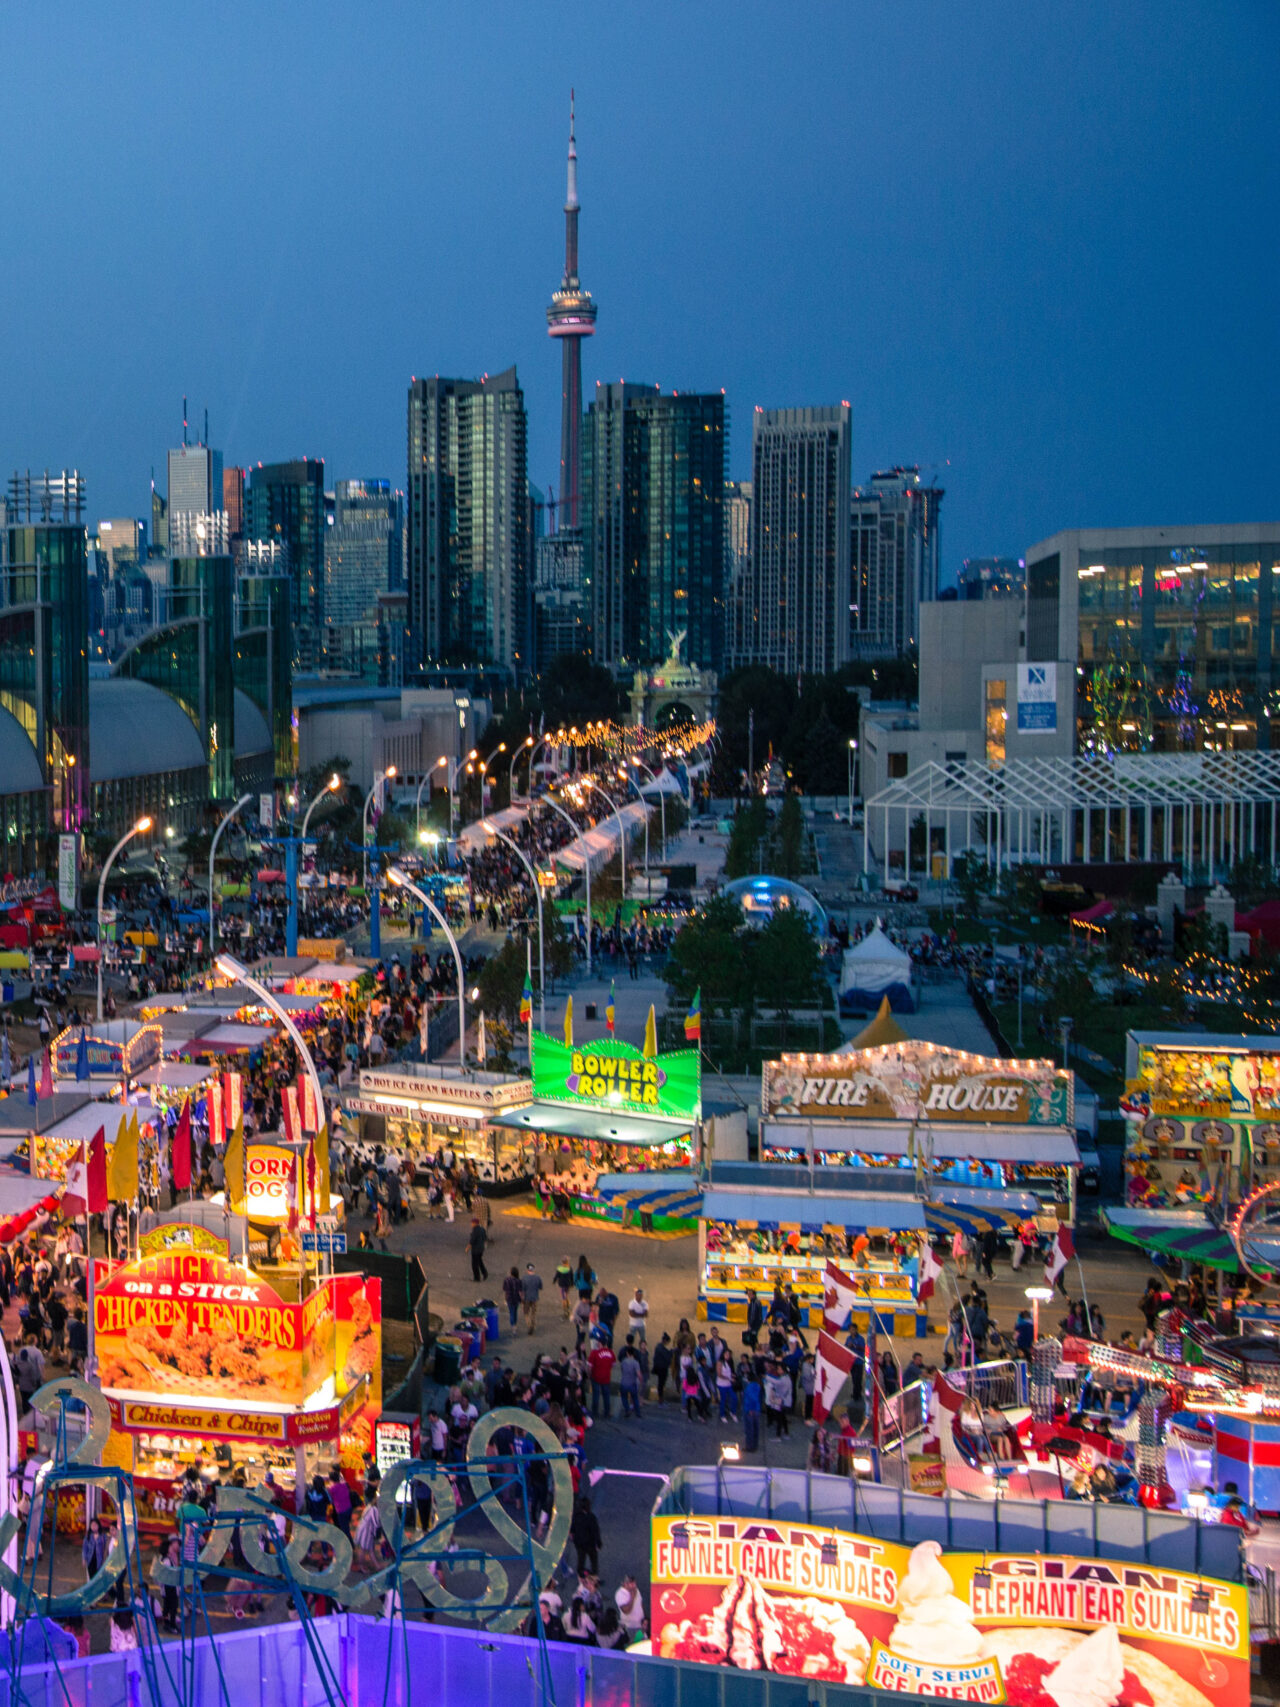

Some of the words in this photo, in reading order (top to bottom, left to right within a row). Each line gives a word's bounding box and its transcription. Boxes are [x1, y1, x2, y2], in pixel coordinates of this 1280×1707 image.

[572, 1053, 658, 1083] BOWLER
[373, 1077, 390, 1087] HOT
[393, 1080, 406, 1089] ICE
[408, 1082, 438, 1093] CREAM
[441, 1087, 481, 1099] WAFFLES
[577, 1075, 659, 1105] ROLLER
[802, 1078, 870, 1107] FIRE
[925, 1084, 1023, 1112] HOUSE
[349, 1100, 365, 1110] ICE
[369, 1104, 403, 1115] CREAM
[419, 1110, 469, 1127] WAFFLES
[249, 1158, 291, 1176] ORN
[249, 1181, 290, 1198] OG
[139, 1255, 248, 1283] CHICKEN
[124, 1281, 153, 1294] on
[158, 1285, 173, 1296] a
[178, 1282, 260, 1302] STICK
[94, 1294, 188, 1334] CHICKEN
[193, 1302, 296, 1350] TENDERS
[127, 1405, 203, 1427] Chicken
[207, 1416, 222, 1429] &
[227, 1413, 280, 1435] Chips
[669, 1520, 884, 1560] GIANT
[658, 1542, 734, 1576] FUNNEL
[741, 1543, 793, 1584] CAKE
[800, 1552, 898, 1606] SUNDAES
[989, 1559, 1230, 1602] GIANT
[972, 1581, 1077, 1620] ELEPHANT
[1085, 1585, 1125, 1624] EAR
[1133, 1590, 1239, 1648] SUNDAES
[878, 1651, 924, 1678] SOFT
[874, 1664, 909, 1692] ICE
[917, 1680, 1000, 1702] CREAM
